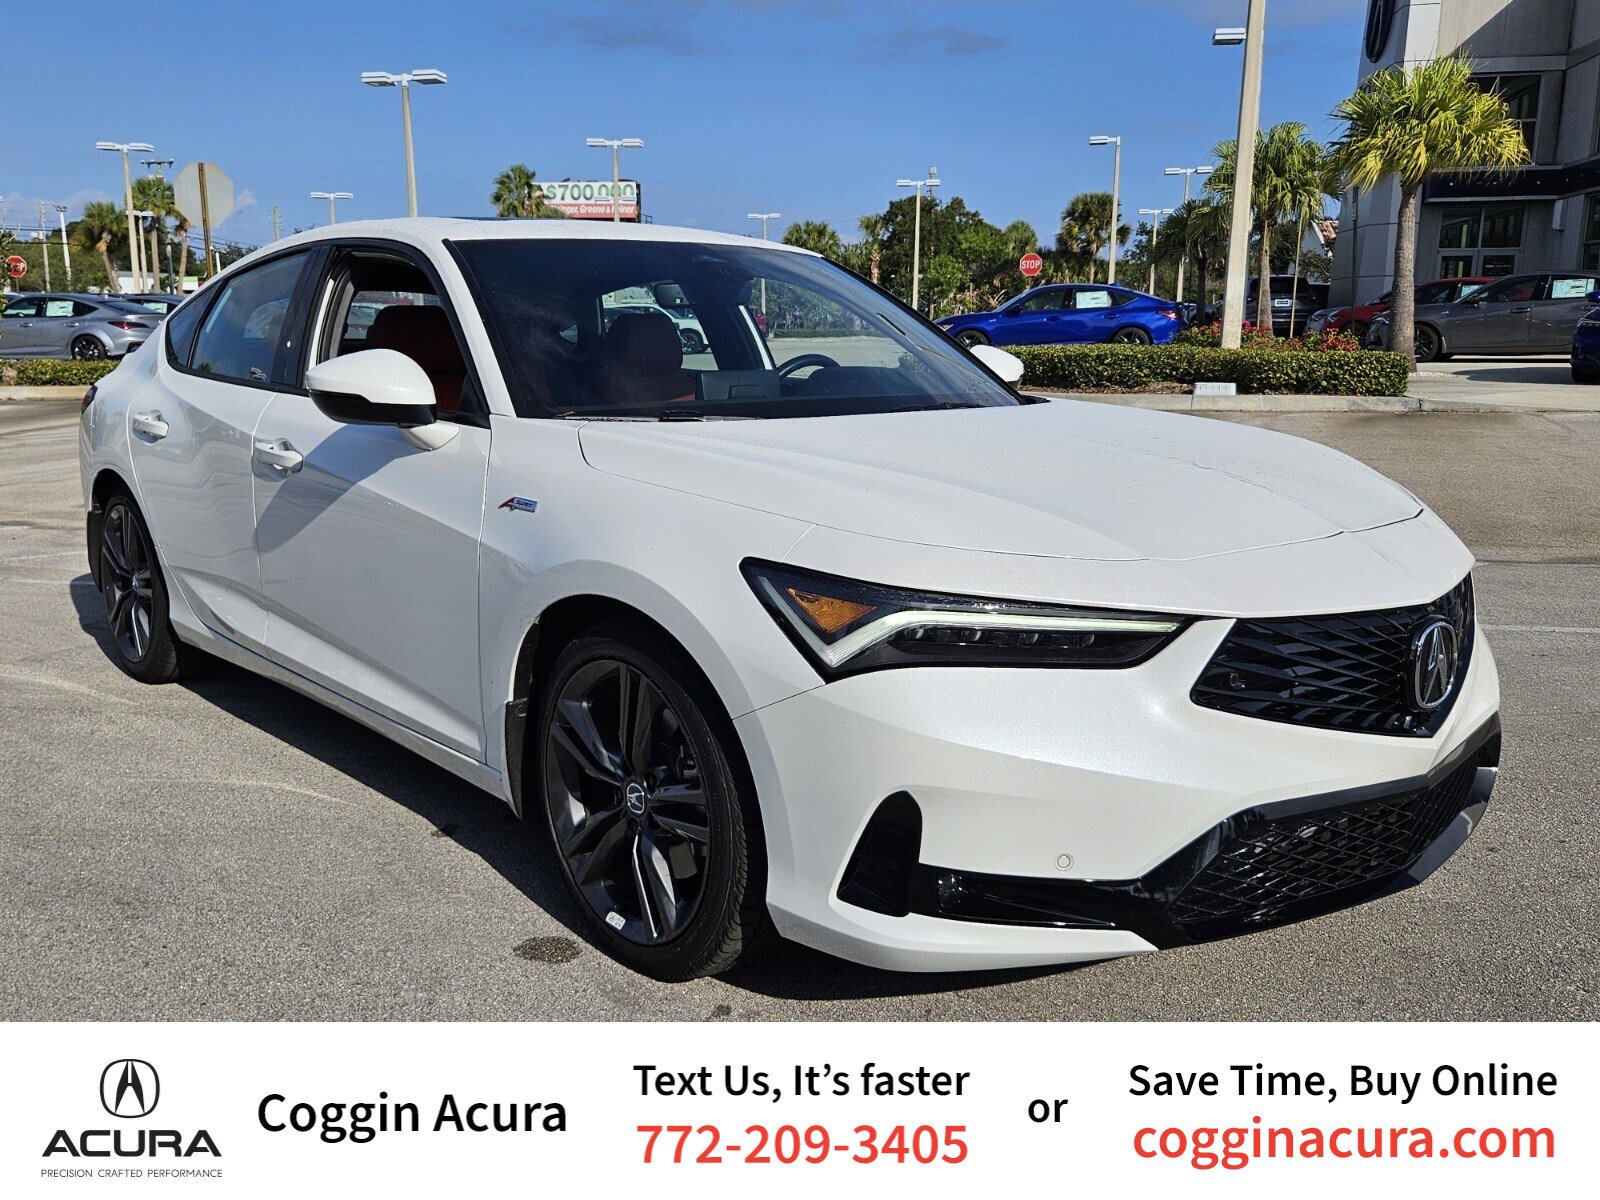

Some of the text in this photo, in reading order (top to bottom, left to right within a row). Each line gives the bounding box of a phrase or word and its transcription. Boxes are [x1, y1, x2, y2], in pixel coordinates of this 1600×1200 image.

[580, 204, 605, 214] Greene
[612, 205, 634, 214] iner
[1021, 260, 1040, 269] STOP
